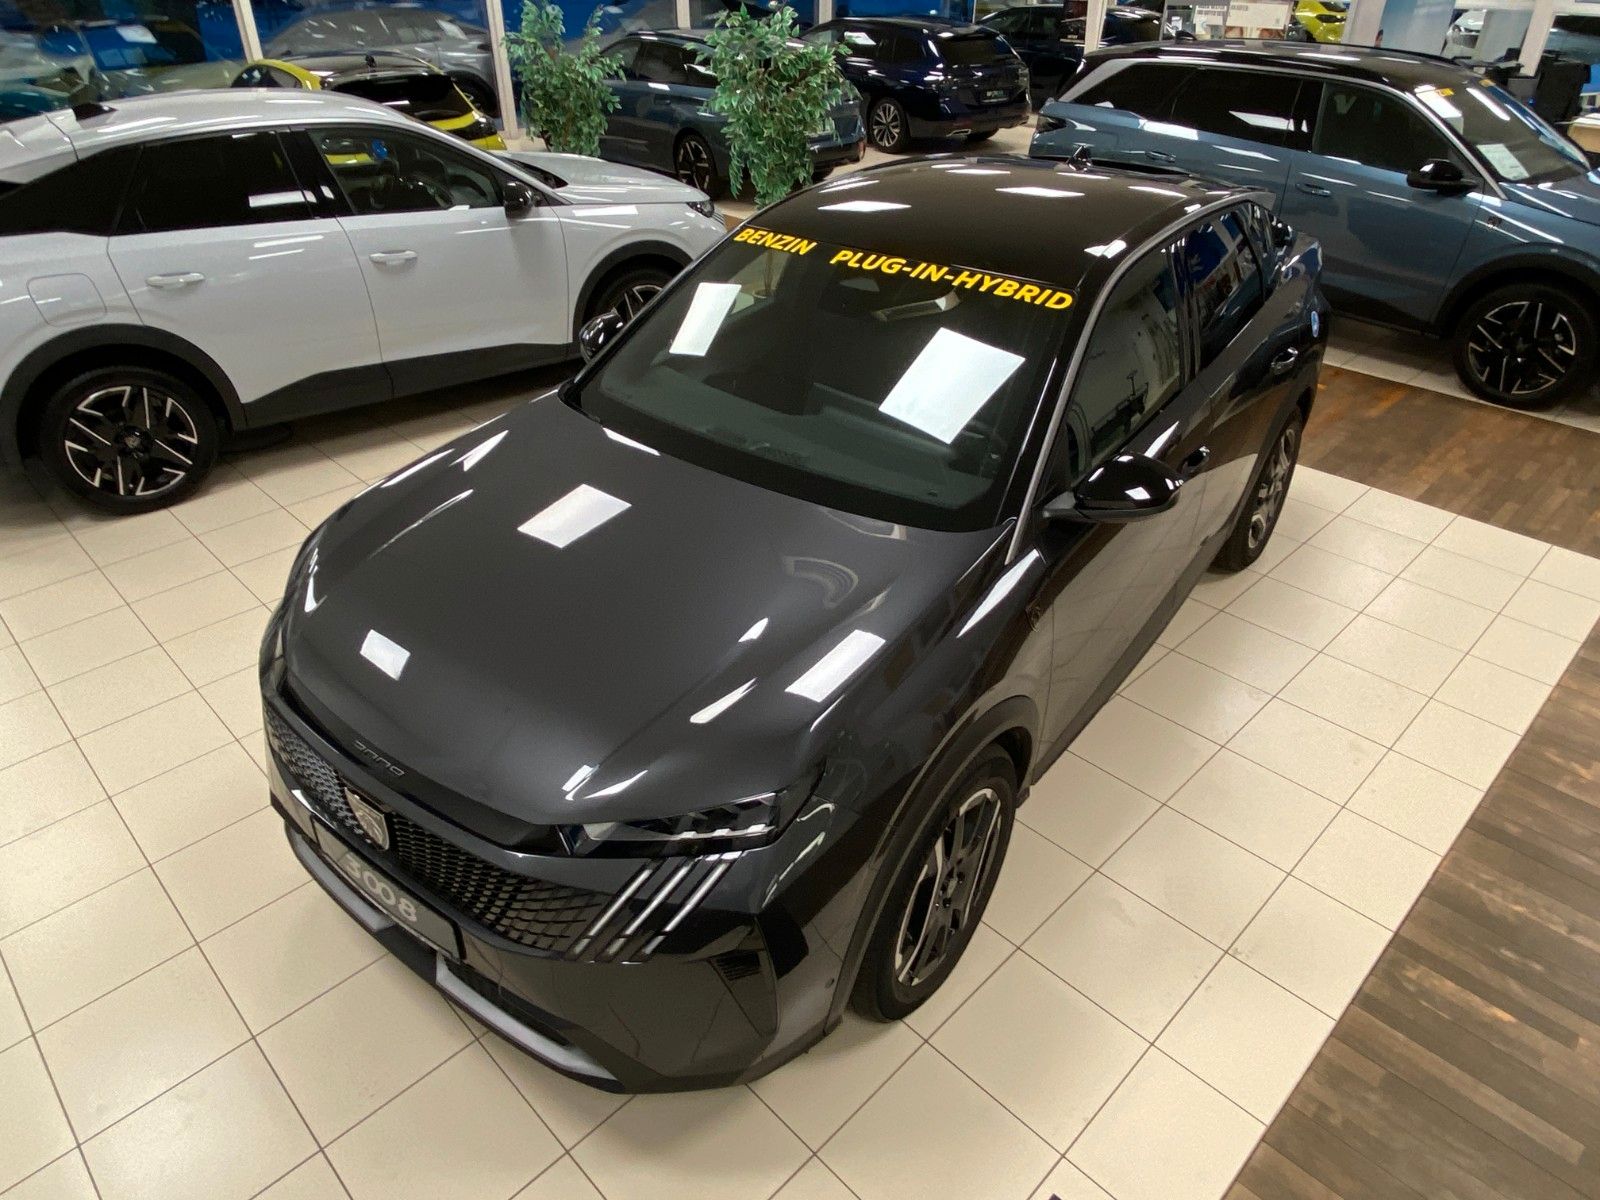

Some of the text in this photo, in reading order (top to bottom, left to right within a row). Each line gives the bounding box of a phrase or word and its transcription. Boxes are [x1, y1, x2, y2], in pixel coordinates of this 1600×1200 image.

[734, 228, 1074, 310] BENZIN PLUG-IN-HYBRID
[346, 852, 418, 921] 3008
